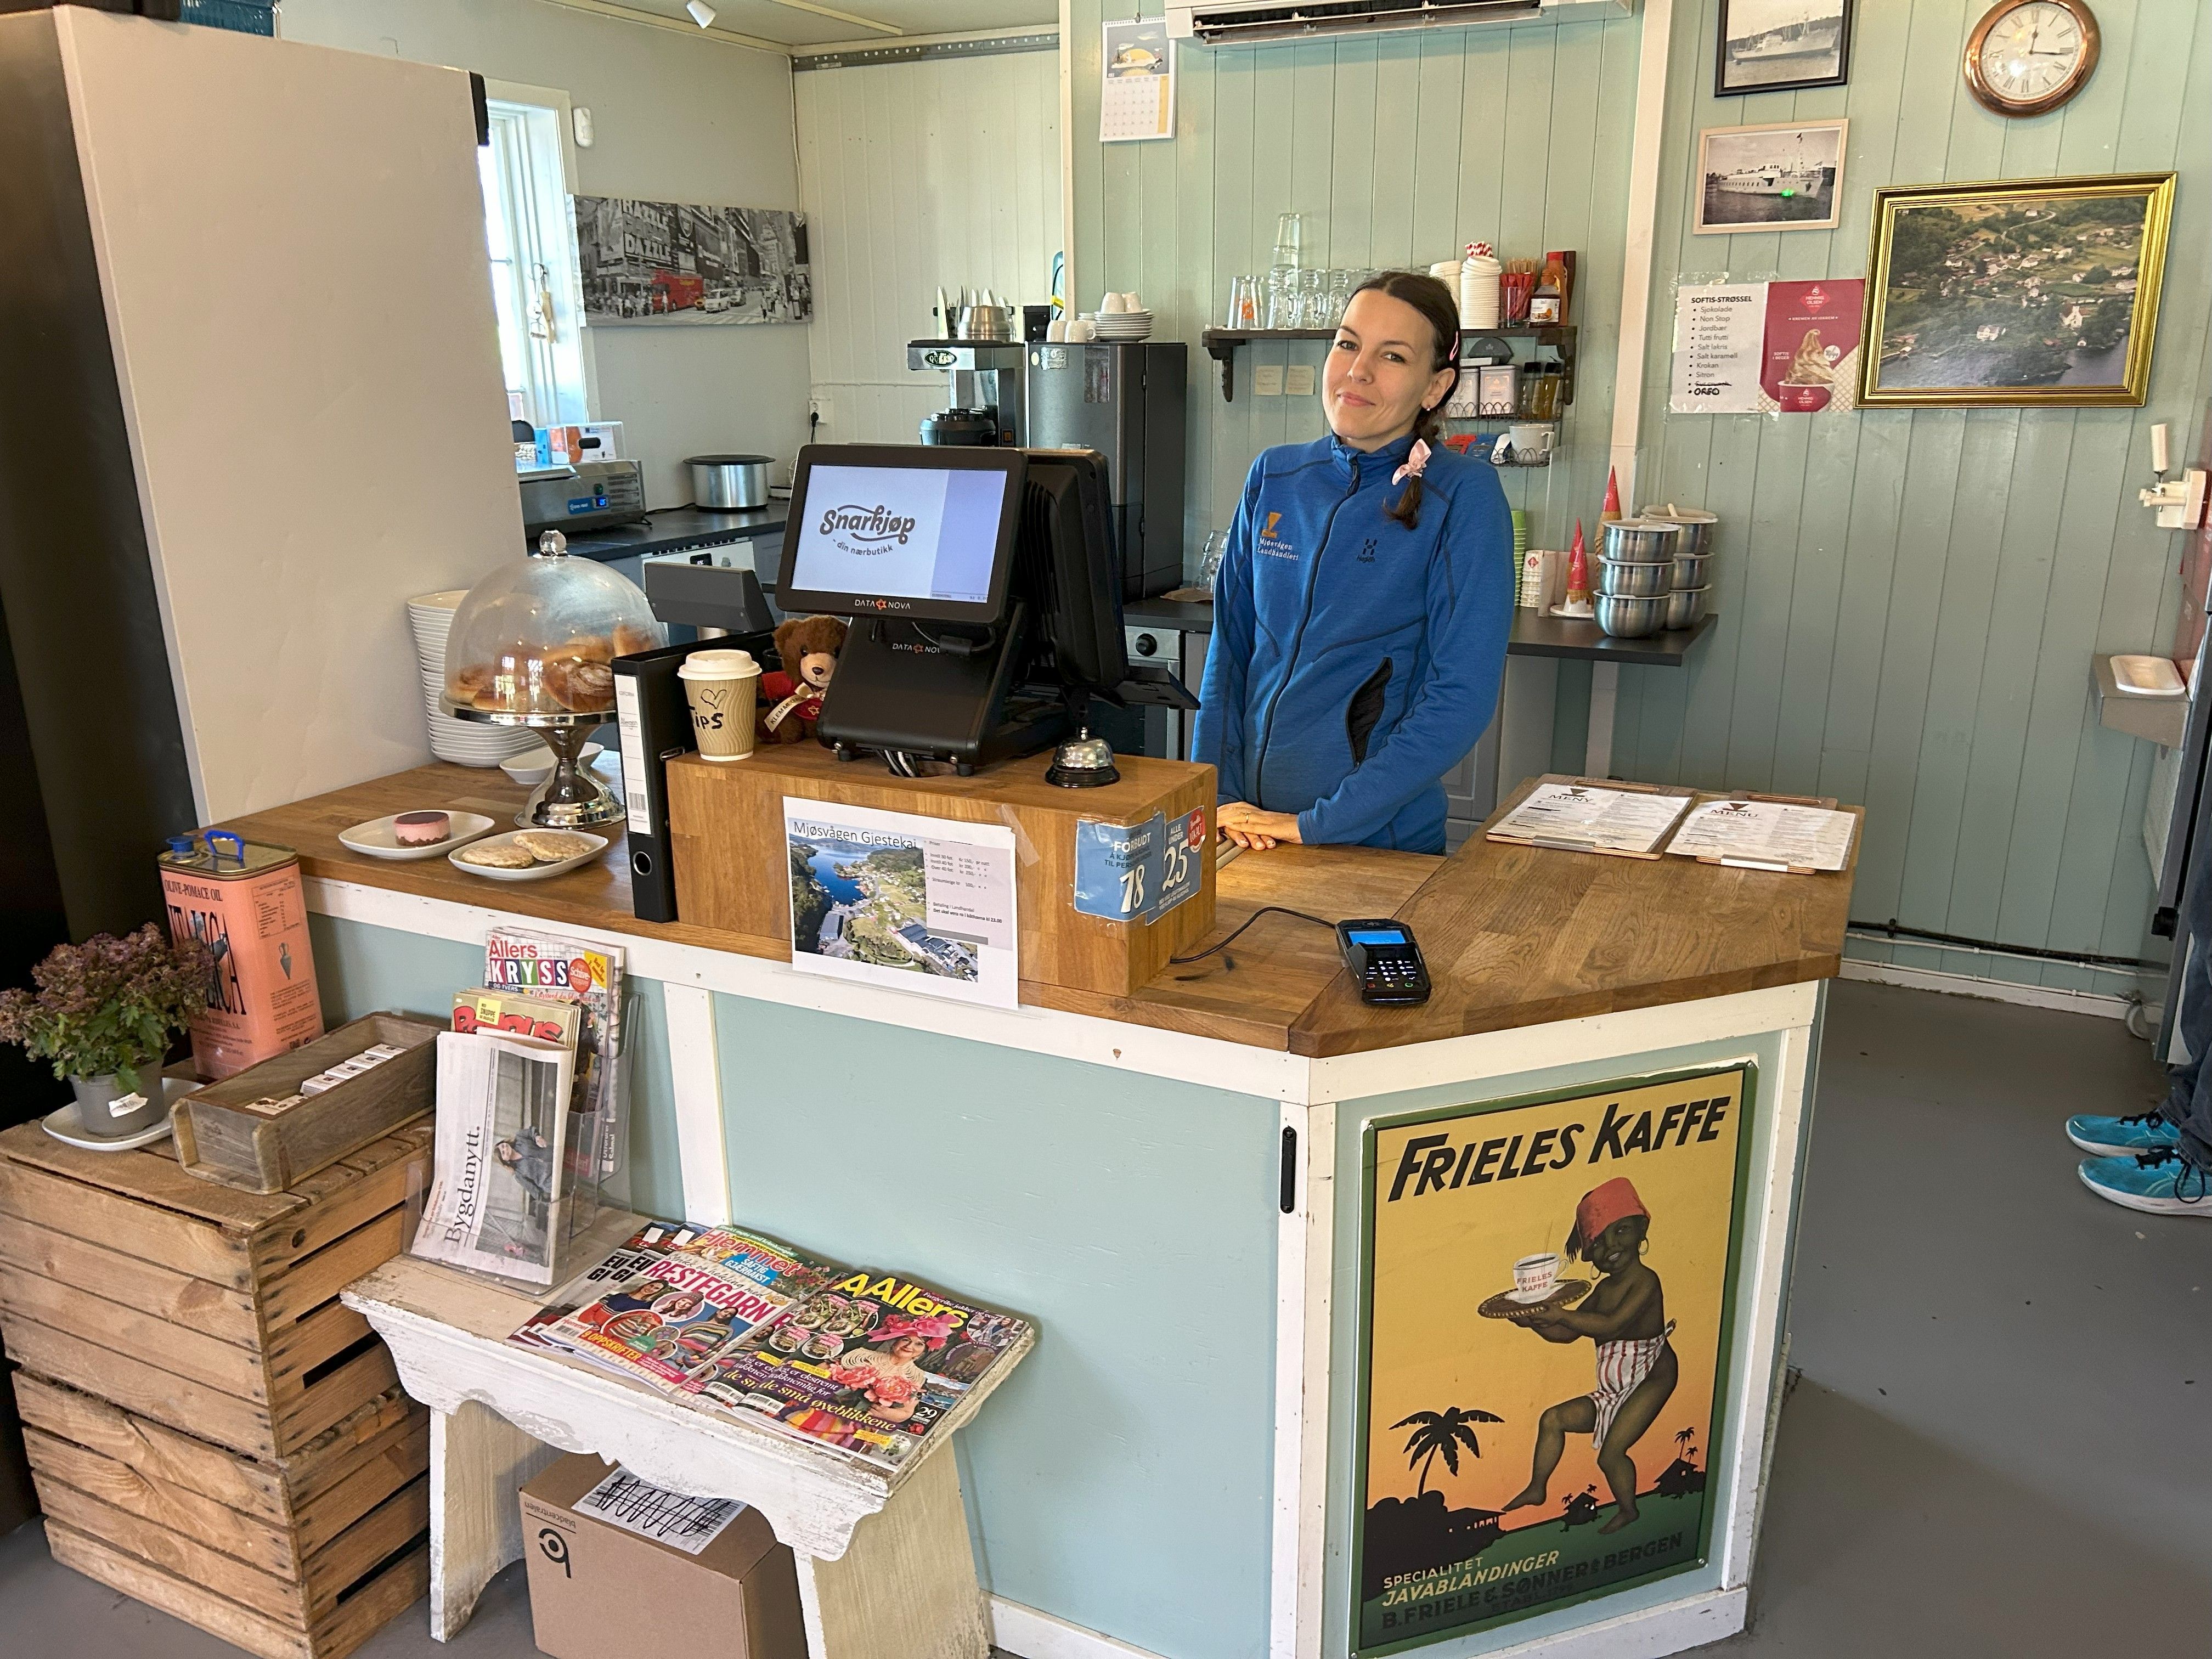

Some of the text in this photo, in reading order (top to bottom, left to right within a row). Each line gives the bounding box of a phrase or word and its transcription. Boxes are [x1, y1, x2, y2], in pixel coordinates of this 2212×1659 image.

[624, 233, 672, 262] DAZZLE
[820, 504, 915, 544] Snarkjøp
[837, 541, 893, 556] din nærbutikk
[1257, 545, 1299, 561] Landhandleri
[854, 599, 911, 610] DATA NOVA
[892, 642, 940, 654] DATA NO
[770, 708, 785, 724] KLEM
[1548, 794, 1593, 803] MENY
[1710, 809, 1759, 818] MENU
[793, 821, 917, 850] Mjøsvågen Gjestekai
[1168, 831, 1183, 845] UNDER
[1170, 823, 1182, 836] ALLE
[1162, 838, 1189, 892] 25
[165, 879, 223, 901] OLIVE-POMACE OIL
[489, 940, 538, 958] Allers
[490, 960, 567, 985] KRYSS
[501, 984, 519, 992] TVERS
[1387, 1096, 1731, 1203] FRIELES KAFFE
[443, 1126, 482, 1244] Bygdanytt.
[702, 1228, 804, 1277] Hjemmet
[724, 1260, 771, 1284] GJÆRBAKST
[741, 1259, 769, 1274] SAFTIG
[1516, 1271, 1553, 1284] FRIELES
[1522, 1282, 1548, 1292] KAFFE
[642, 1260, 777, 1323] RESTEGARN
[588, 1333, 642, 1361] OPPSKRIFTER
[723, 1370, 740, 1380] de
[800, 1370, 839, 1391] ekstremt
[814, 1387, 831, 1397] for
[759, 1379, 776, 1390] de
[777, 1386, 813, 1404] små
[810, 1399, 896, 1431] øyeblikkene
[915, 1406, 938, 1419] 29
[524, 1501, 576, 1529] bladcentralen
[1384, 1556, 1483, 1589] SPECIALITET
[1500, 1561, 1590, 1599] SØNNER
[1603, 1532, 1683, 1570] BERGEN
[1381, 1550, 1560, 1607] JAVABLANDINGER
